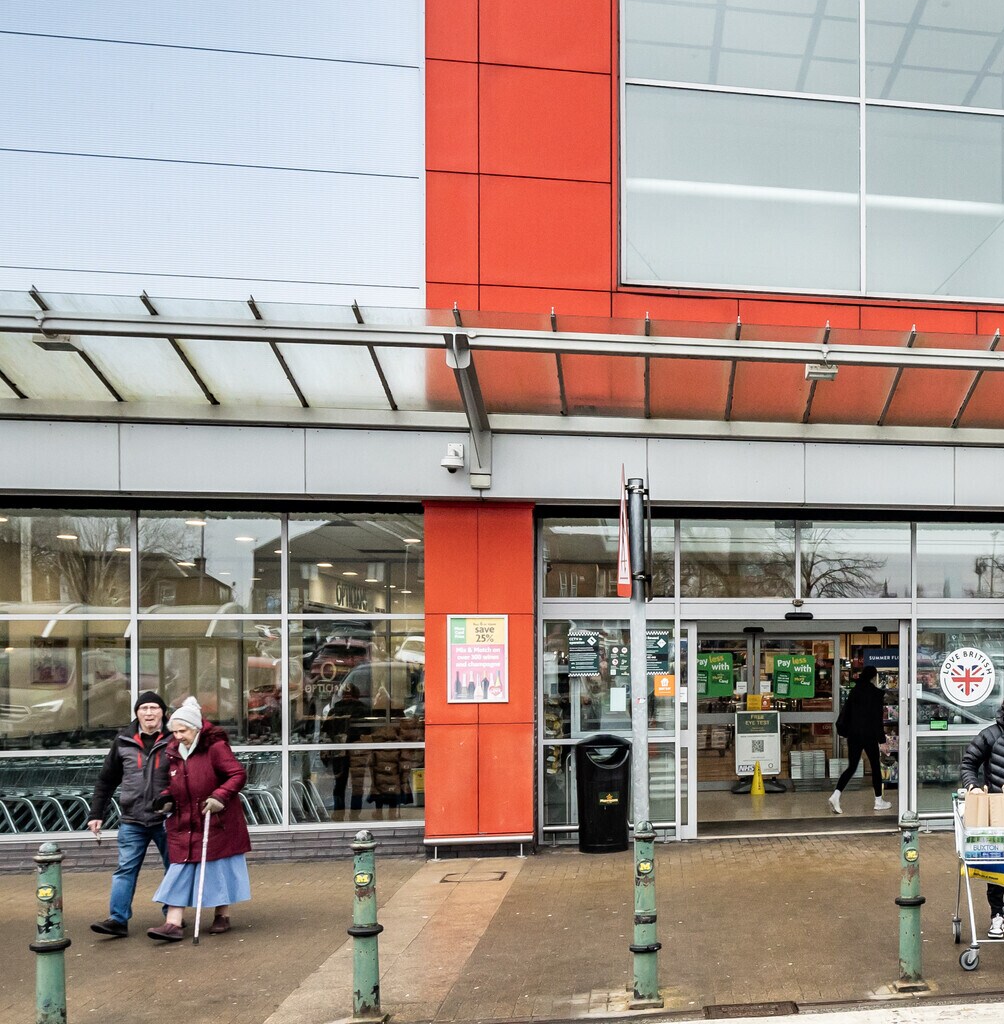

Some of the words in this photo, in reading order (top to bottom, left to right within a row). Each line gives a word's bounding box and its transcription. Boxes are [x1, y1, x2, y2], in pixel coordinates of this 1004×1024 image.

[474, 626, 495, 634] save
[476, 634, 495, 642] 25%
[777, 659, 790, 668] Pay
[943, 653, 960, 674] LOVE
[962, 650, 992, 675] BRITISH
